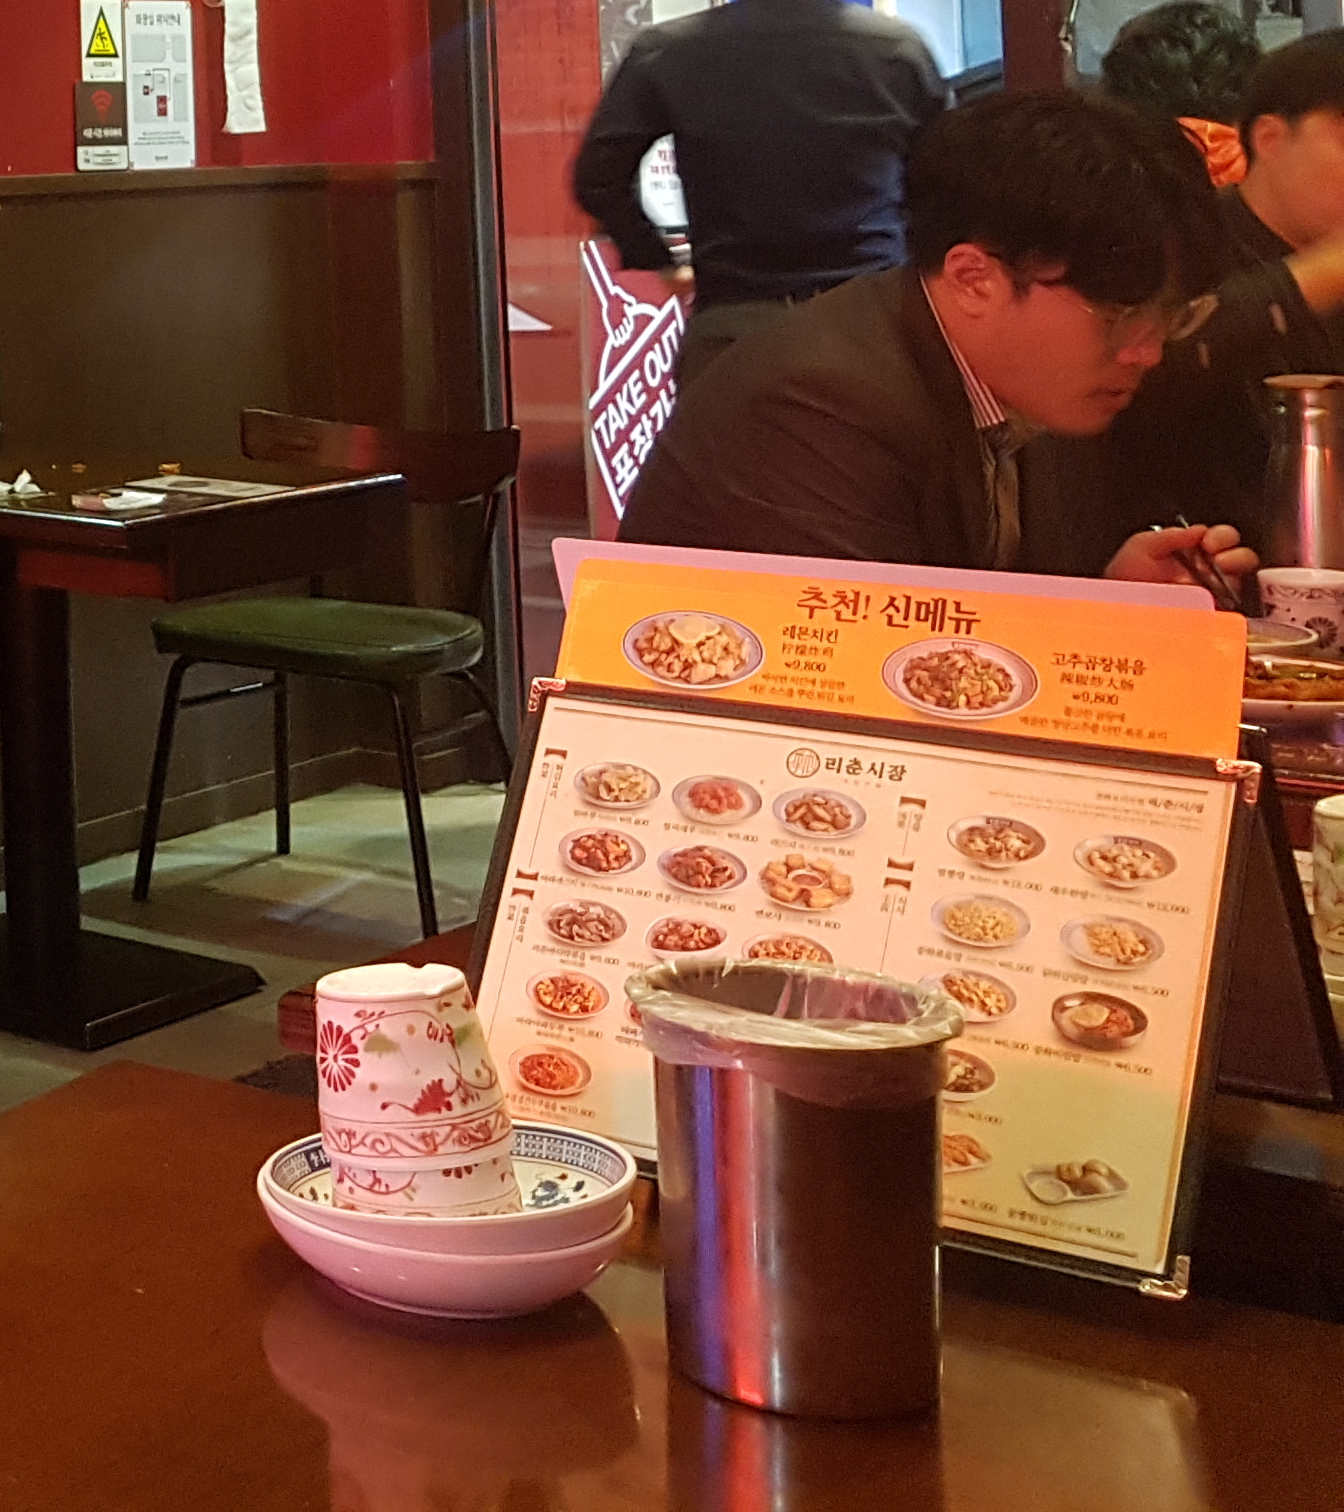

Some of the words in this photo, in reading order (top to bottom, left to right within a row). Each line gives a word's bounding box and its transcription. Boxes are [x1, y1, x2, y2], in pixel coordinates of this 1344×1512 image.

[594, 369, 647, 449] TAKE
[644, 319, 680, 383] OUT
[796, 586, 871, 624] 추천!
[879, 593, 981, 636] 신메뉴
[782, 625, 839, 644] 레몬치킨
[824, 756, 907, 782] 리춘시장
